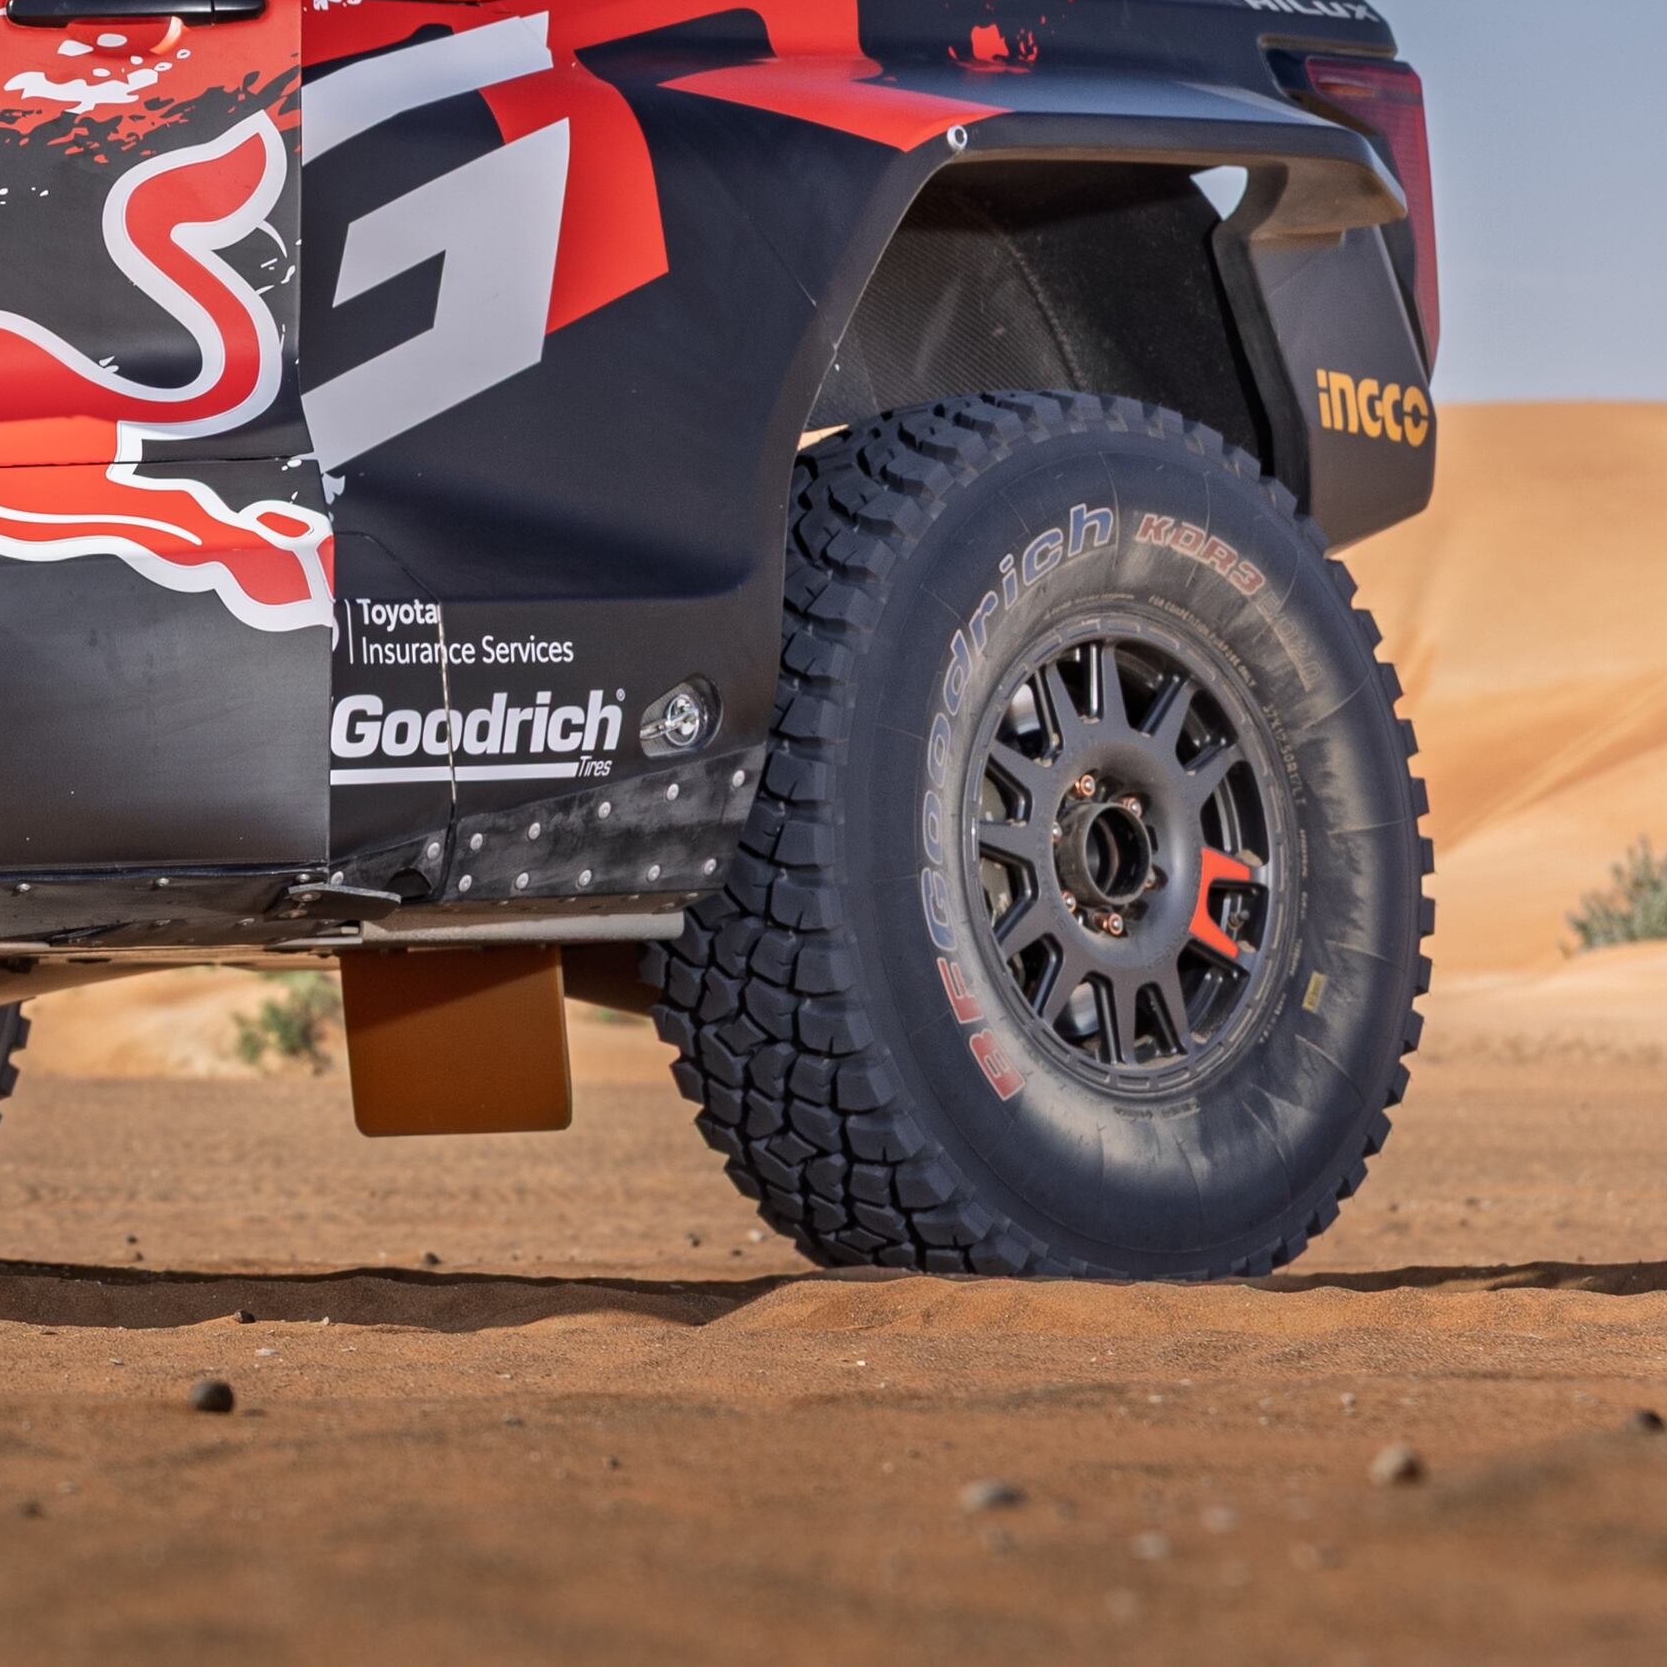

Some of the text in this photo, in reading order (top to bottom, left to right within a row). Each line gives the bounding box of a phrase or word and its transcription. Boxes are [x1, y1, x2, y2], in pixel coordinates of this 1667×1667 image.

[1316, 368, 1429, 447] ingco
[357, 598, 439, 632] Toyota
[363, 635, 574, 665] Insurance Services
[577, 756, 612, 778] Tires
[920, 502, 1115, 1101] BFGoodrich
[1135, 513, 1267, 596] KDR3
